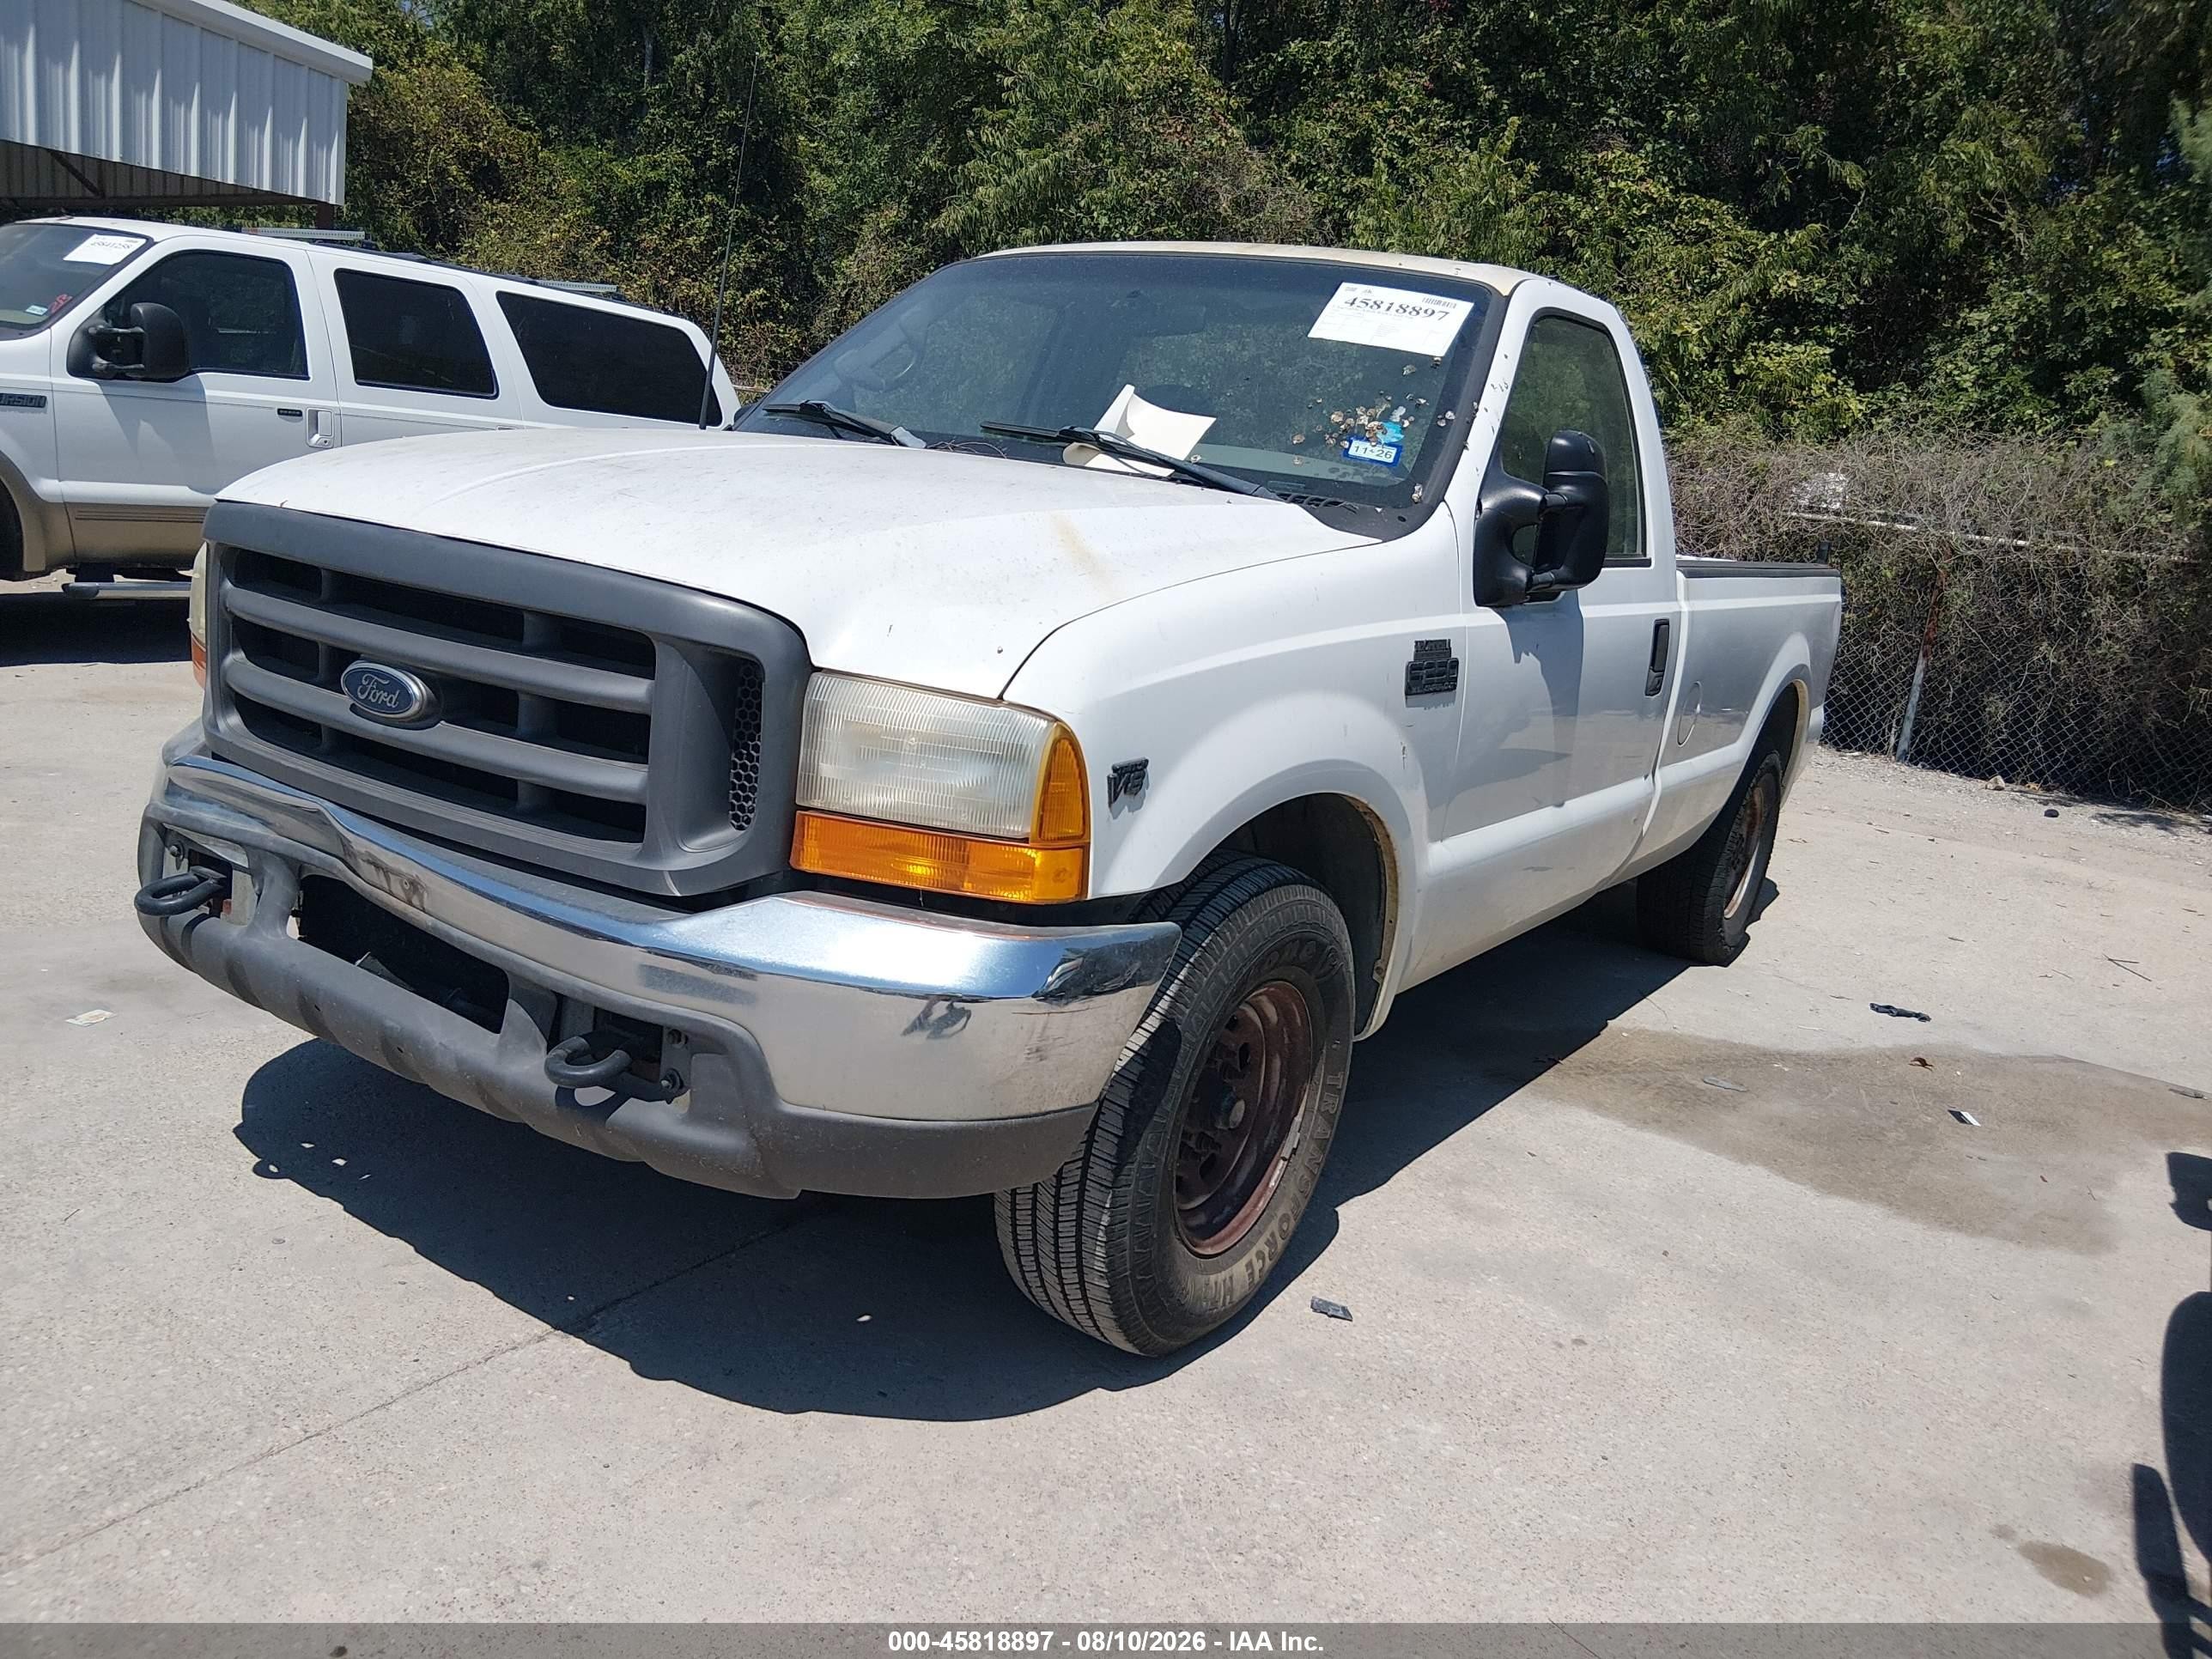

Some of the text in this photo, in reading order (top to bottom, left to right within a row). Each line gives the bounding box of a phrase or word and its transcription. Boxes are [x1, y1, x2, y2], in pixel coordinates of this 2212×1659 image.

[1344, 296, 1450, 321] 45818897
[356, 672, 400, 708] Ford
[1244, 1071, 1345, 1290] TRANSFORCE
